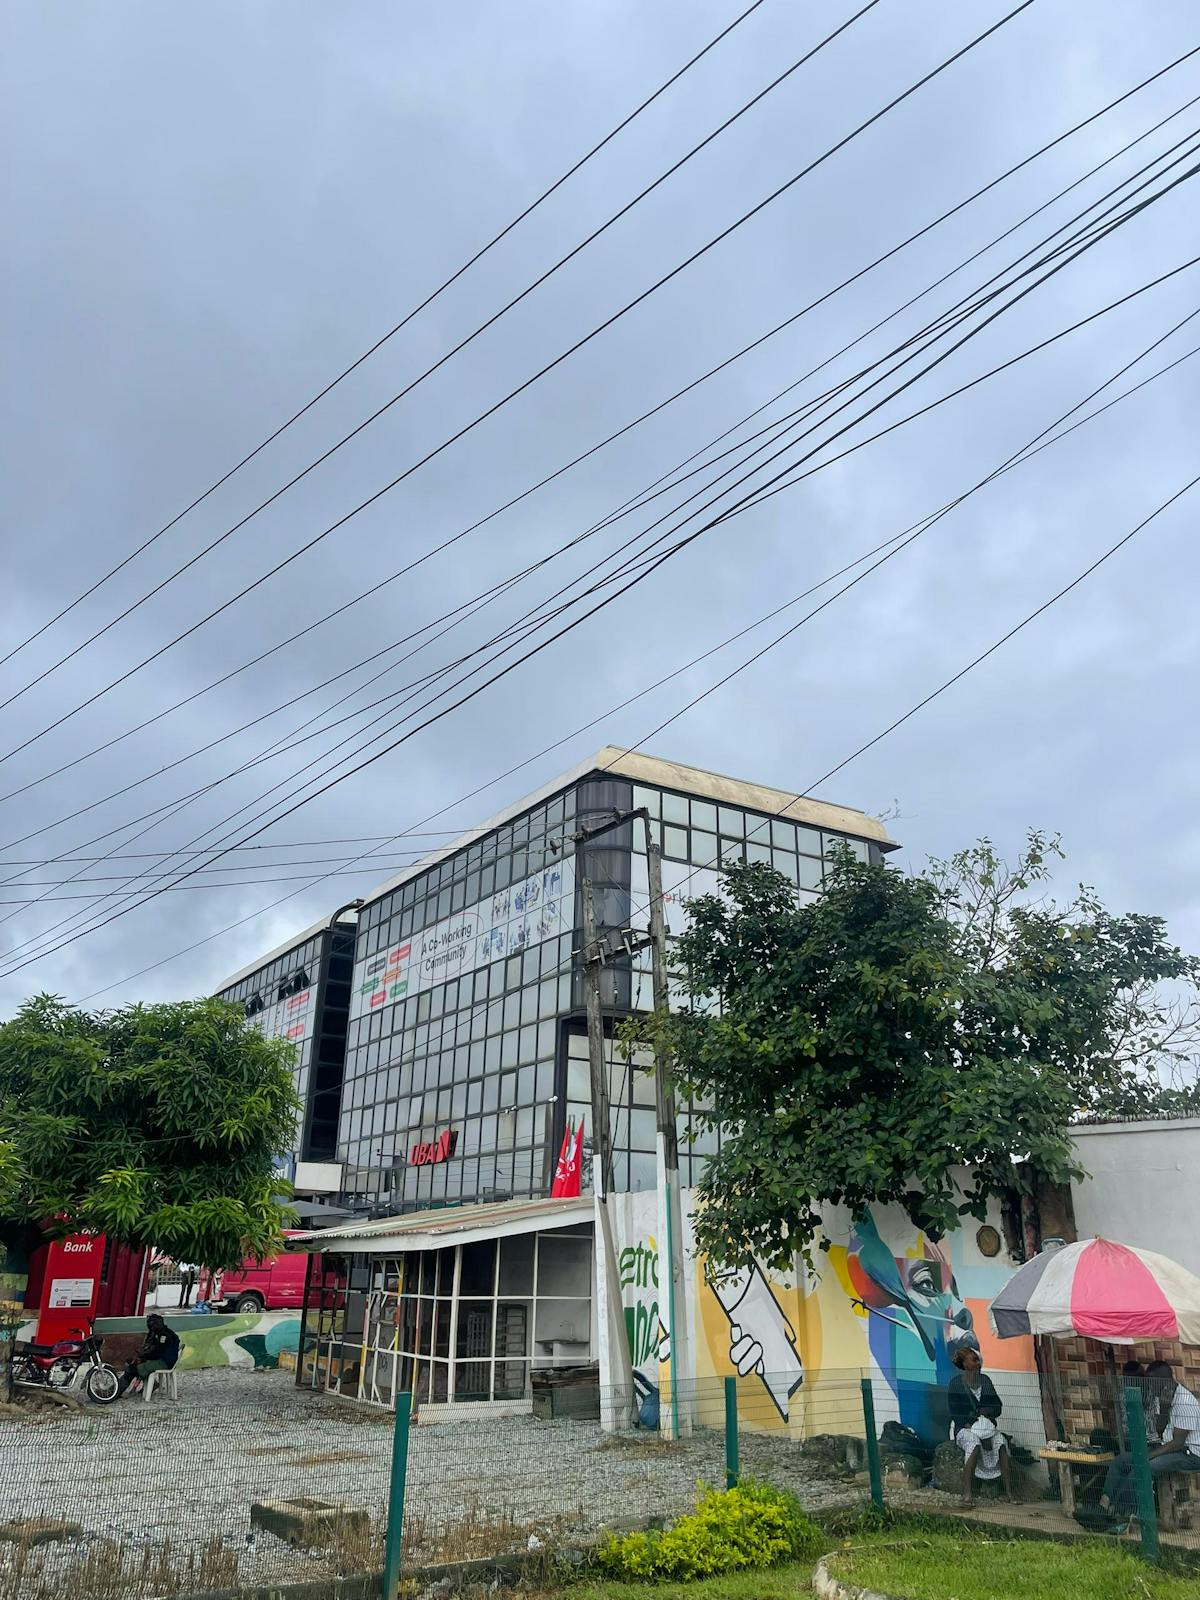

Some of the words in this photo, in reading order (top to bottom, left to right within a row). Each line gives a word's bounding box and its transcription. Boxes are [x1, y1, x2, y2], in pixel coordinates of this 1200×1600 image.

[429, 924, 472, 952] Co-Working
[425, 945, 467, 971] Community
[410, 1141, 437, 1166] UBA
[63, 1241, 93, 1252] Bank
